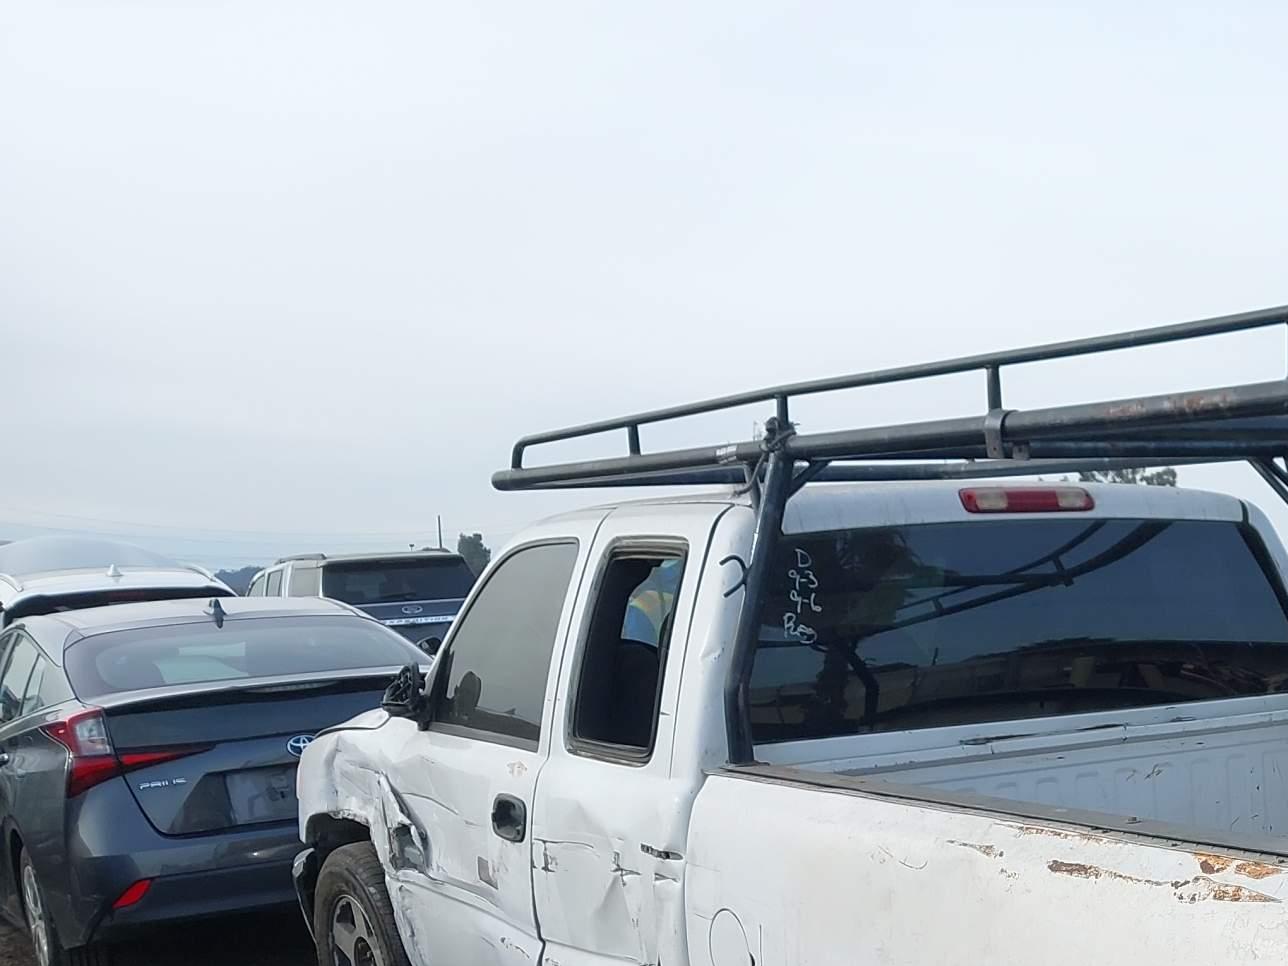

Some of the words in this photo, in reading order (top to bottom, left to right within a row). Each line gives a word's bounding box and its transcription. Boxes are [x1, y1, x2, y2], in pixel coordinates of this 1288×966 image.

[794, 548, 812, 567] D
[788, 569, 818, 590] 9-3
[790, 590, 822, 613] 9-6
